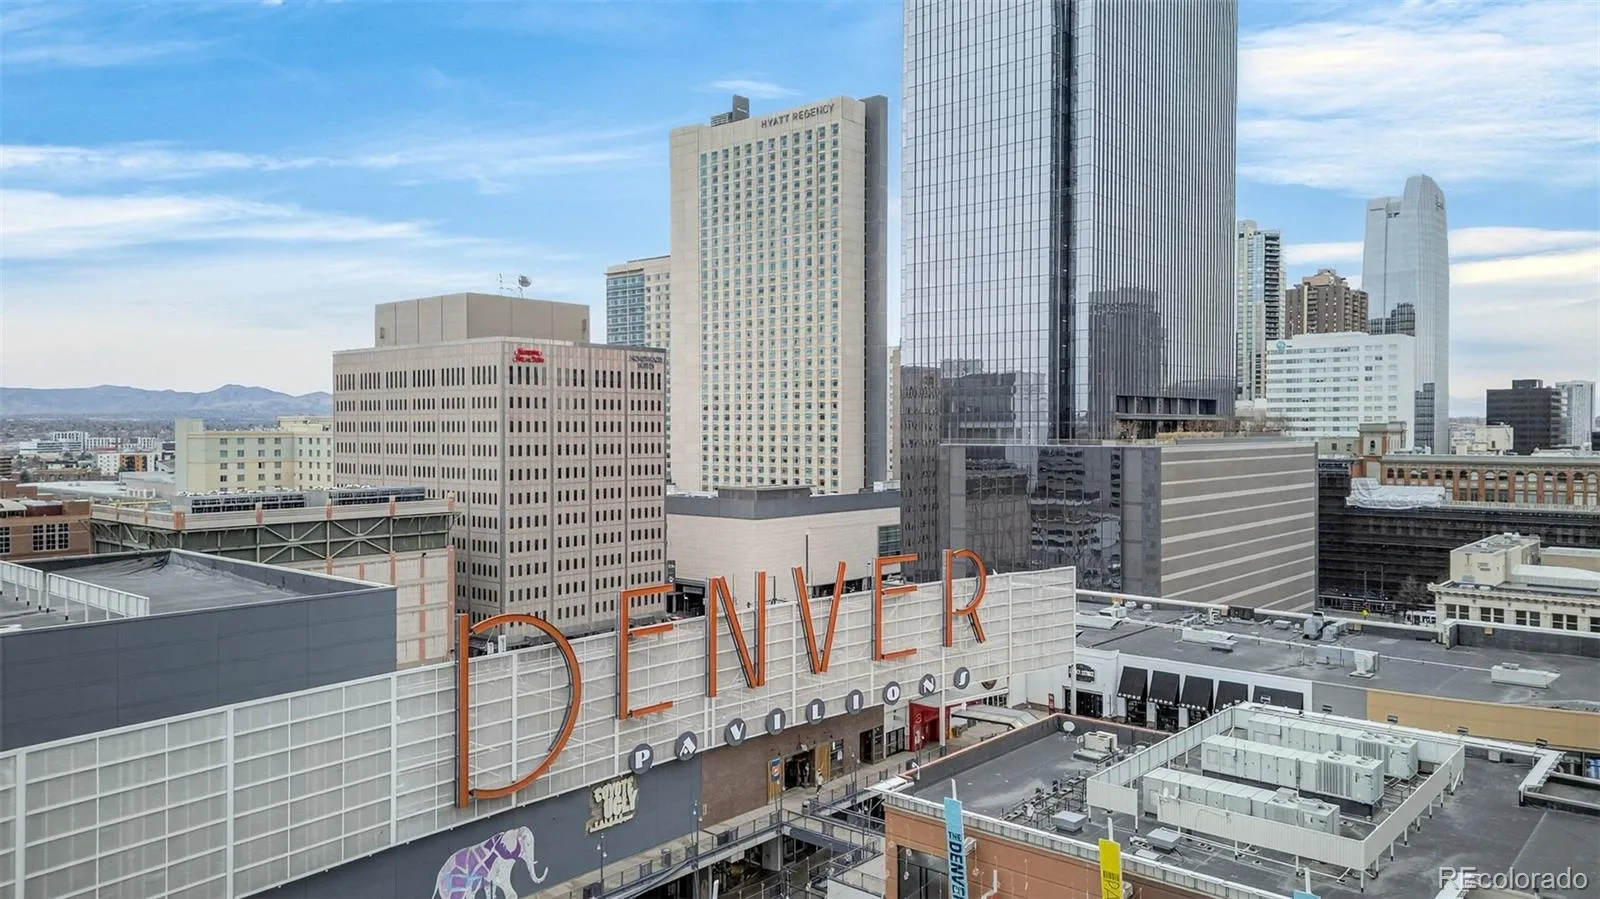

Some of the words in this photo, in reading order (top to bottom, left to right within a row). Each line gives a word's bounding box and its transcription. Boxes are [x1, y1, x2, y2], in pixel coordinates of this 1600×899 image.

[761, 114, 790, 128] HYATT
[792, 104, 835, 121] REGENCY
[455, 547, 987, 809] DENVER
[634, 670, 969, 770] PAVILIONS
[603, 787, 638, 818] UGLY
